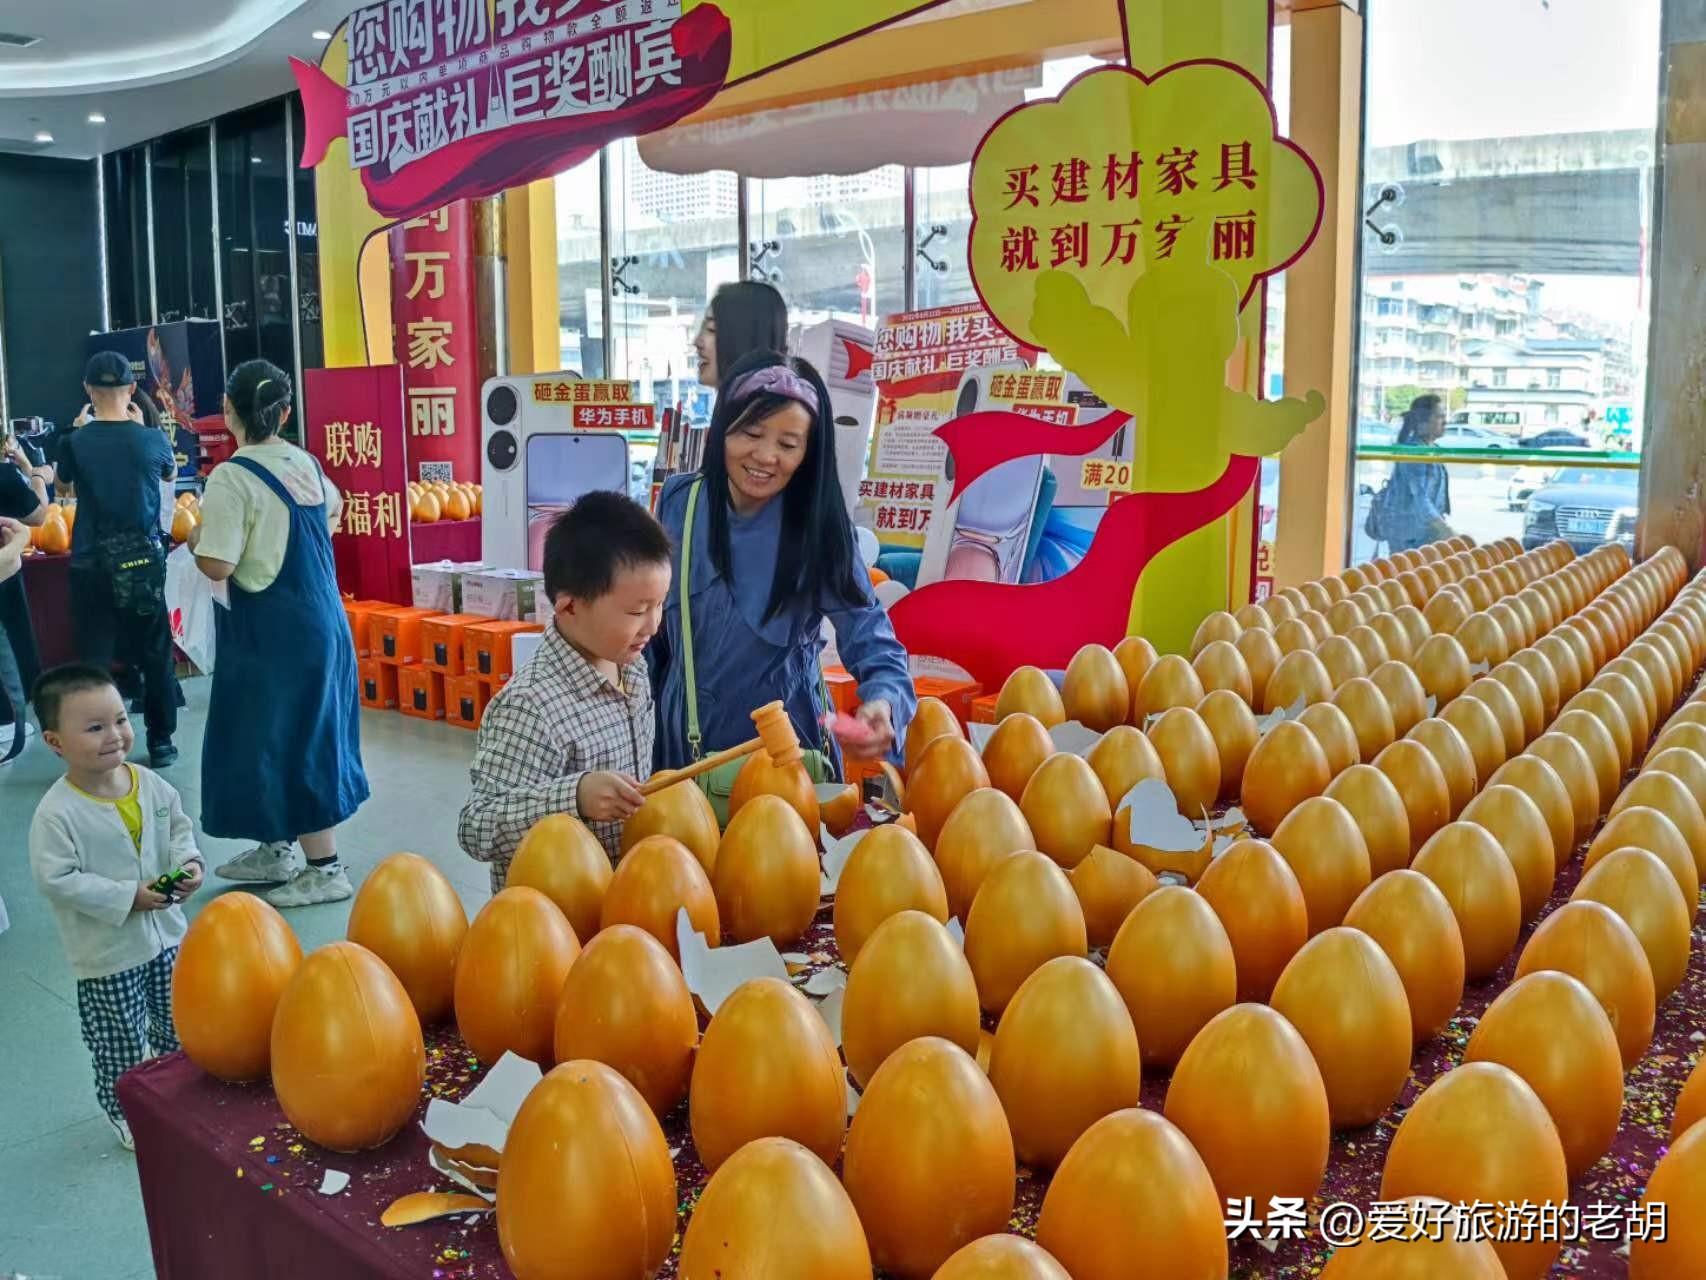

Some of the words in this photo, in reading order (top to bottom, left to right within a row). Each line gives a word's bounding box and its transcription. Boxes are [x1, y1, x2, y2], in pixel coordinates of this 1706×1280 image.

[350, 77, 484, 165] 国庆献礼
[504, 19, 682, 121] 巨奖酬宾
[1002, 140, 1258, 211] 买建材家具
[875, 314, 1003, 352] 您购物我买
[871, 355, 937, 381] 国庆献礼
[534, 382, 629, 401] 砸金蛋赢取
[990, 374, 1062, 400] 砸金蛋赢取
[579, 407, 648, 425] 华为手机
[324, 421, 382, 468] 联购
[858, 480, 935, 500] 买建材家具
[334, 490, 403, 538] 福利
